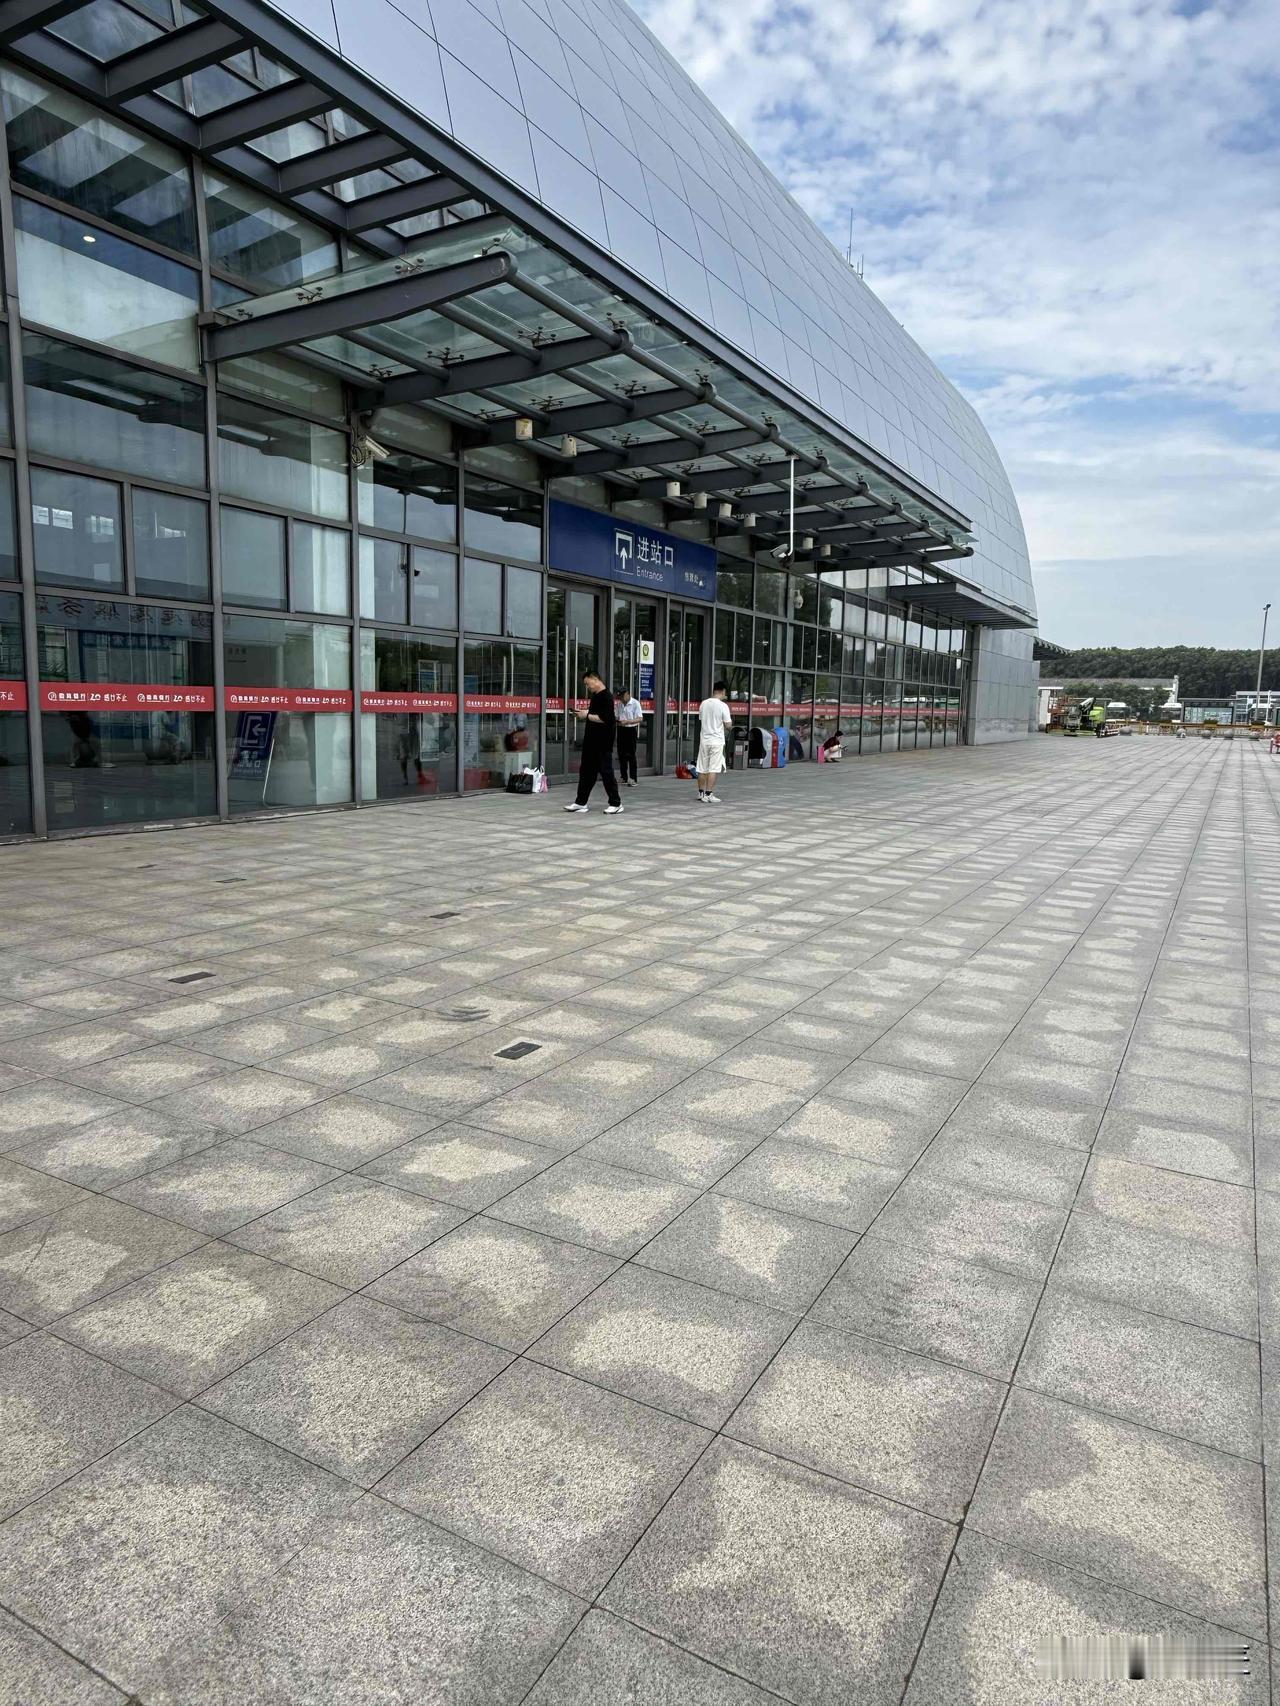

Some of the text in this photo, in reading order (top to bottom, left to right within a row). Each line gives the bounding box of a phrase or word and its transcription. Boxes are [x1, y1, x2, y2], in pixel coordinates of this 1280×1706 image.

[637, 536, 674, 568] 进站口
[636, 566, 664, 582] Entrance
